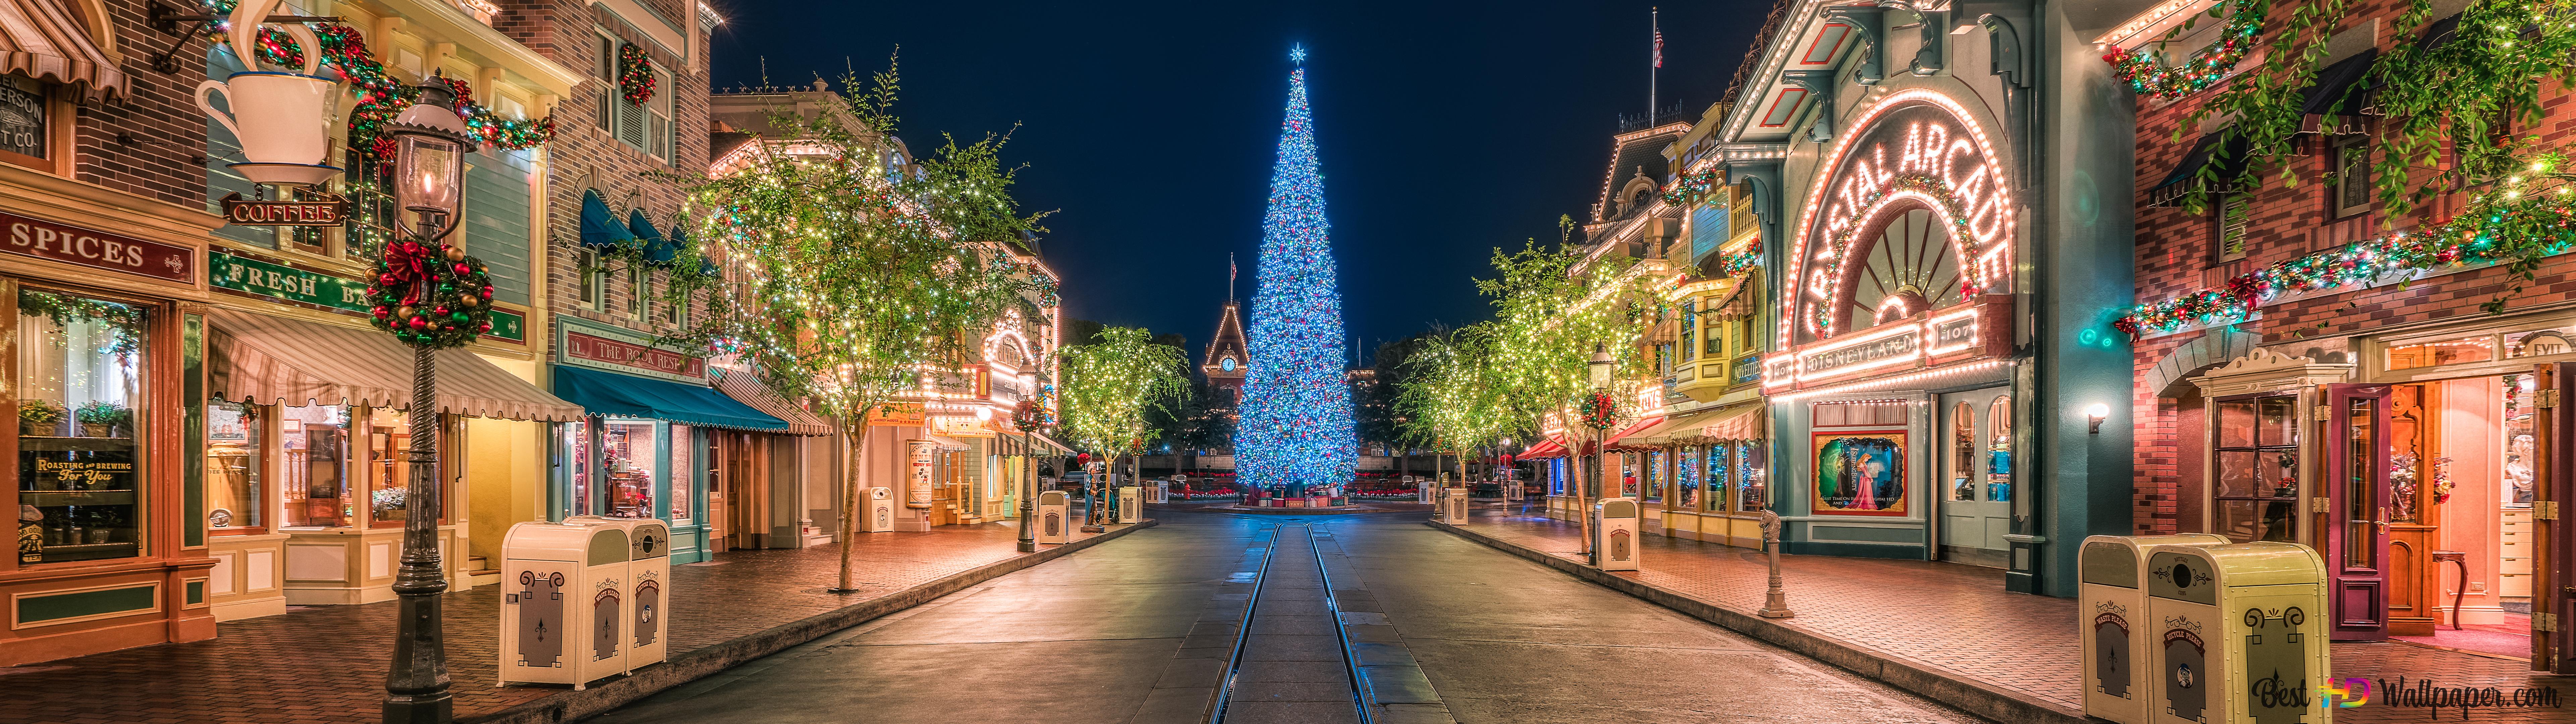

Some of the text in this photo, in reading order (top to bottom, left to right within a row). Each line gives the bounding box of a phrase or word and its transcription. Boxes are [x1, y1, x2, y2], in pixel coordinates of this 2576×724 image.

[14, 132, 37, 147] CO.
[234, 203, 336, 224] COFFEE
[1899, 121, 2010, 289] ARCADE
[10, 223, 144, 267] SPICES
[229, 263, 317, 297] FRESH
[1946, 324, 1970, 341] 107
[597, 342, 680, 370] THE BOOK REST
[1811, 337, 1913, 372] DISNEYLAND
[2534, 344, 2563, 356] EXIT
[1734, 360, 1762, 380] NOVELTIES
[1639, 390, 1660, 410] TOYS
[38, 459, 84, 471] ROASTING
[58, 469, 112, 484] For You
[637, 581, 658, 592] RECYCLE PLEASE
[596, 590, 619, 602] WASTE PLEASE
[2097, 615, 2127, 629] WASTE PLEASE
[2166, 631, 2202, 647] RECYCLE PLEASE
